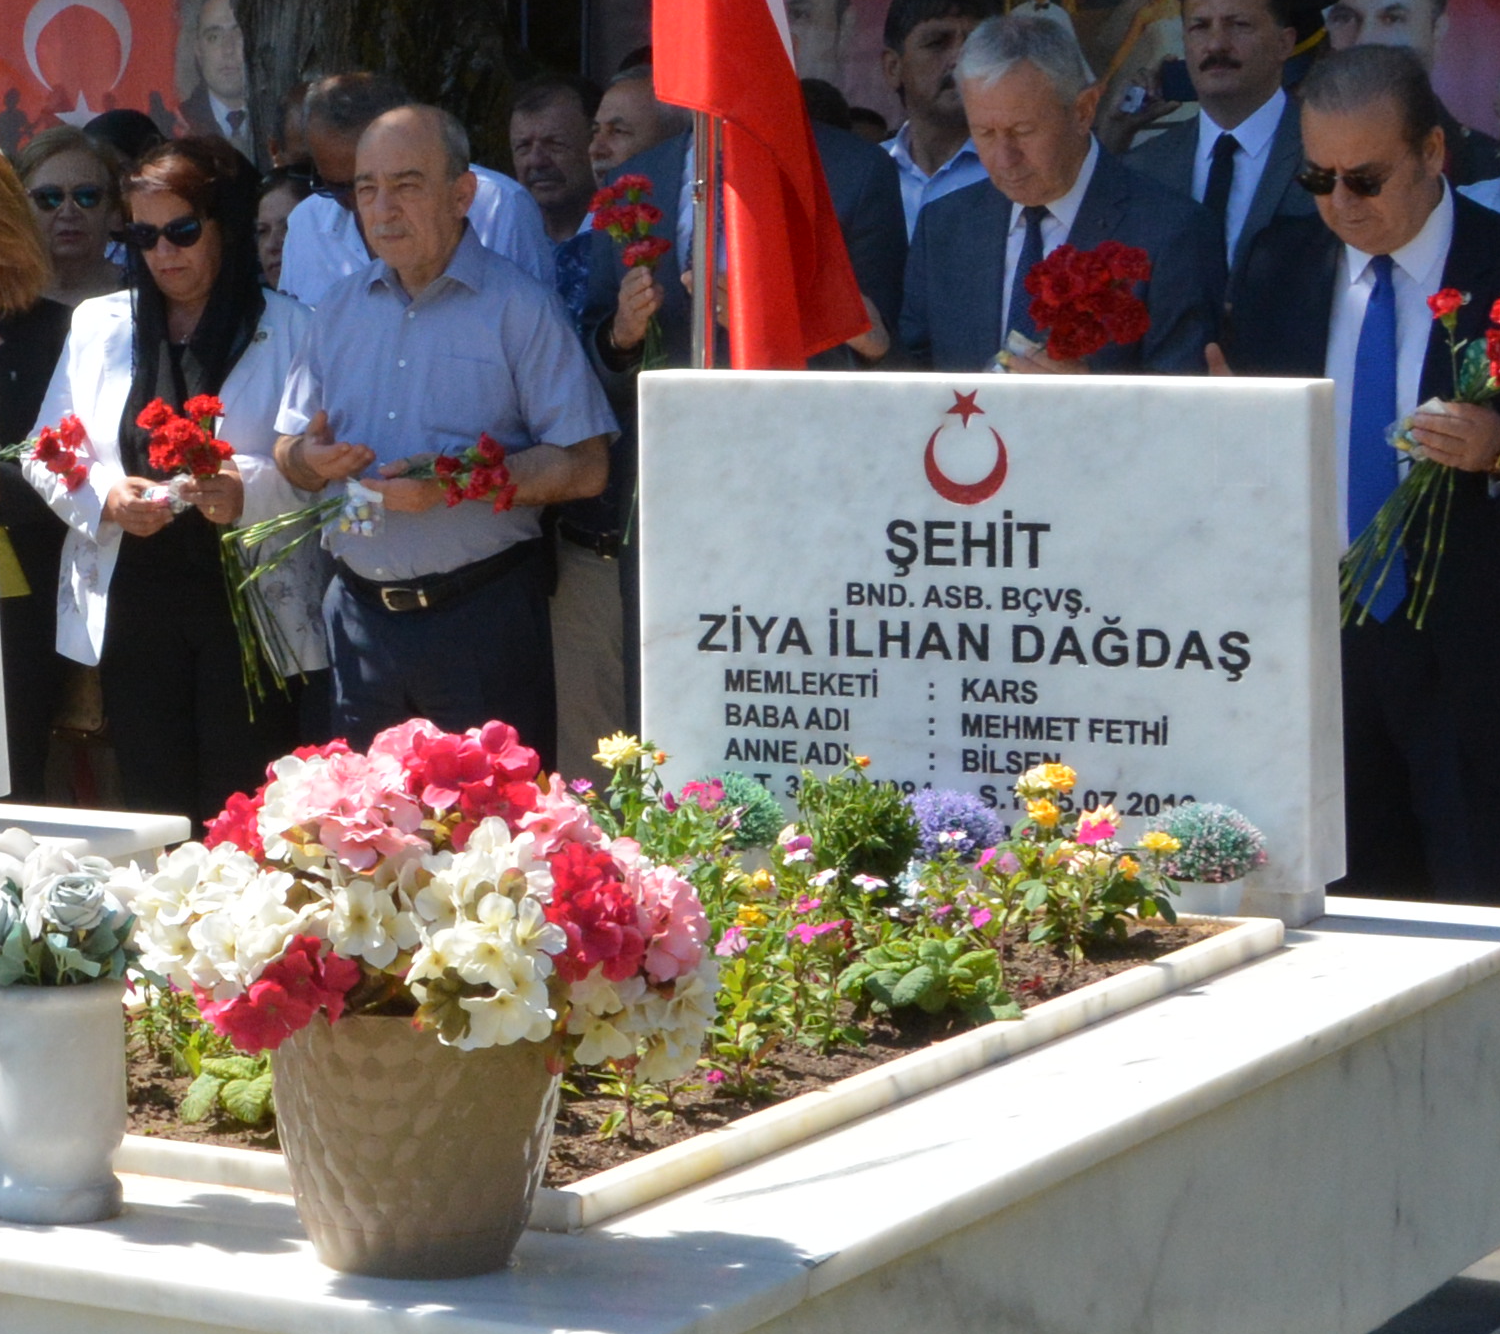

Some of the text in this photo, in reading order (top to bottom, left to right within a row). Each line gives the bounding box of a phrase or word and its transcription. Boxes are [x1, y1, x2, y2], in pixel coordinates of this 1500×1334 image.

[885, 509, 1051, 577] ŞEHİT
[846, 582, 1092, 616] BND. ASB. BÇVŞ.
[697, 604, 1252, 683] ZİYA İLHAN DAĞDAŞ
[724, 668, 879, 699] MEMLEKETİ
[961, 678, 1039, 705] KARS
[724, 703, 799, 730] BABA
[805, 708, 850, 732] ADI
[961, 713, 1081, 743] MEHMET
[1089, 715, 1169, 747] FETHİ
[724, 737, 798, 764] ANNE
[804, 741, 851, 767] ADI
[1054, 788, 1197, 818] 5.07.201
